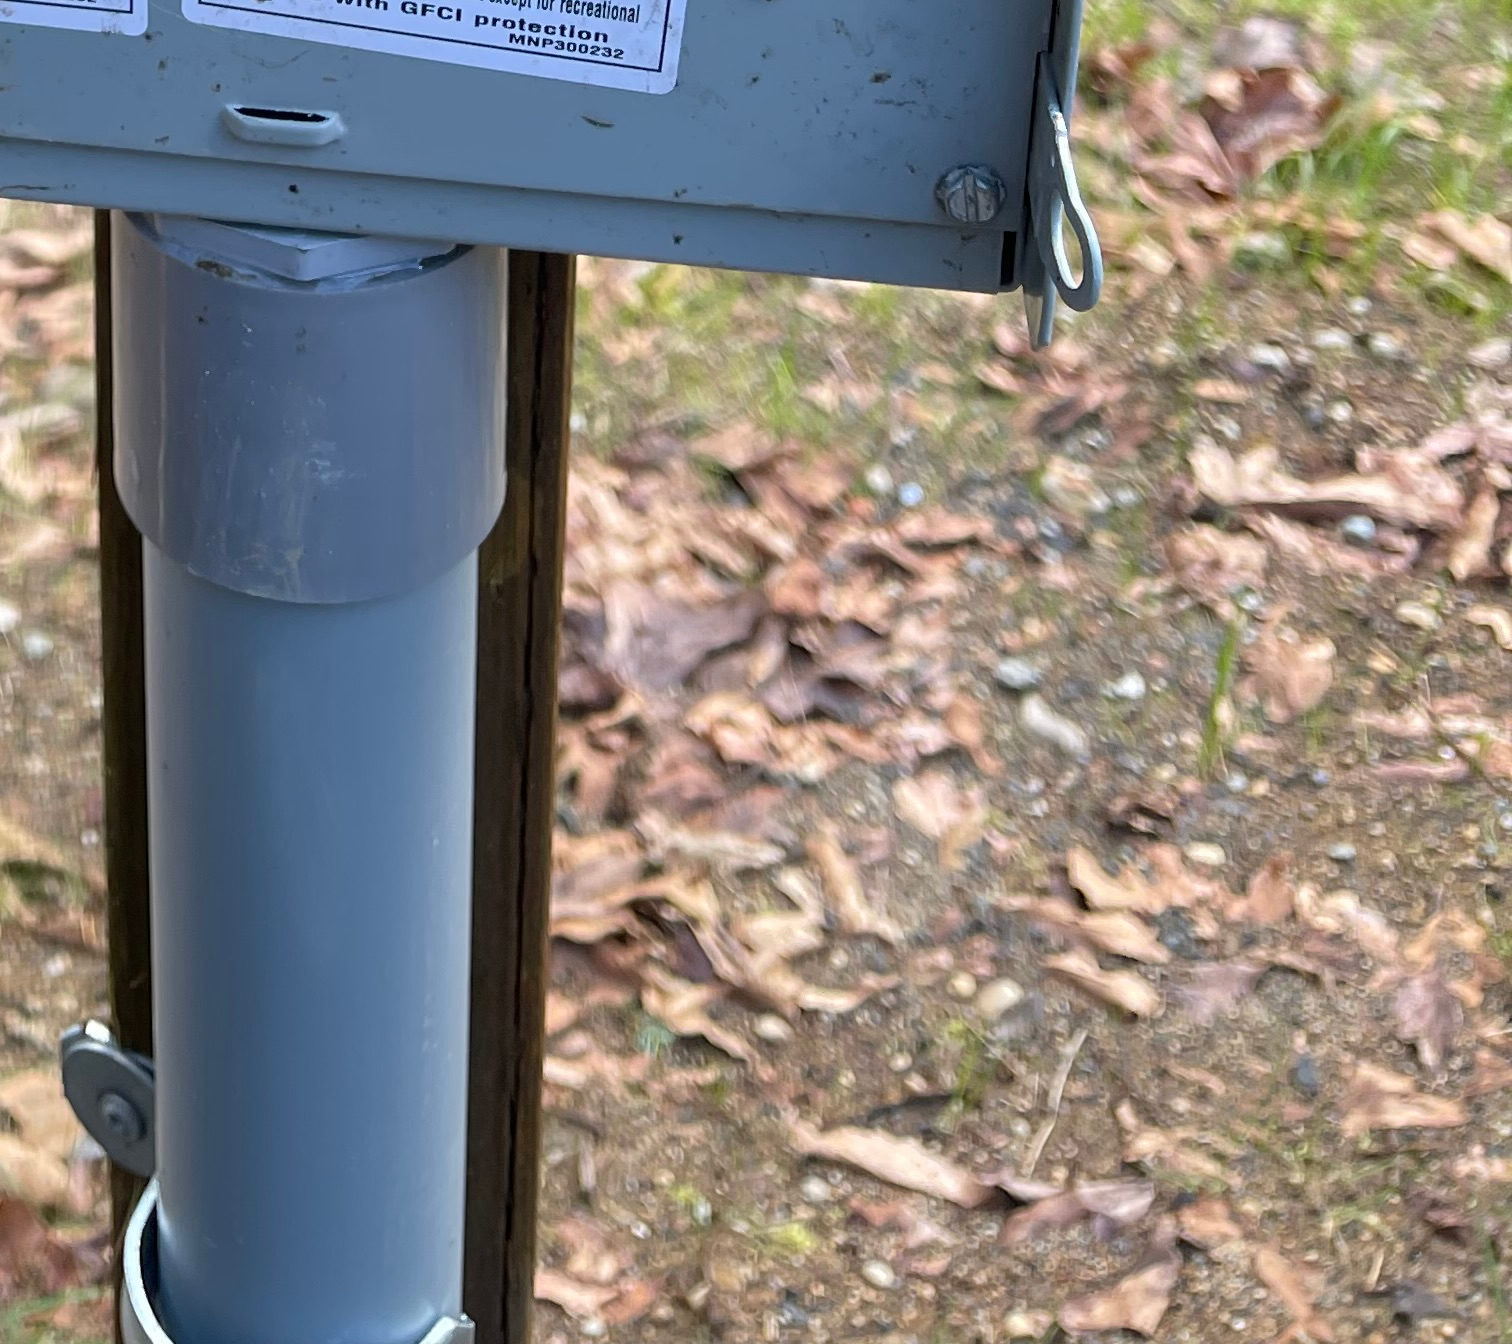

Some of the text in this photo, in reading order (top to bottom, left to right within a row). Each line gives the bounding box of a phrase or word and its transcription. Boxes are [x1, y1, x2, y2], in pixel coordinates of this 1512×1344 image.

[400, 1, 462, 22] GFCI
[474, 14, 608, 43] protection
[509, 33, 625, 60] MNP300232
